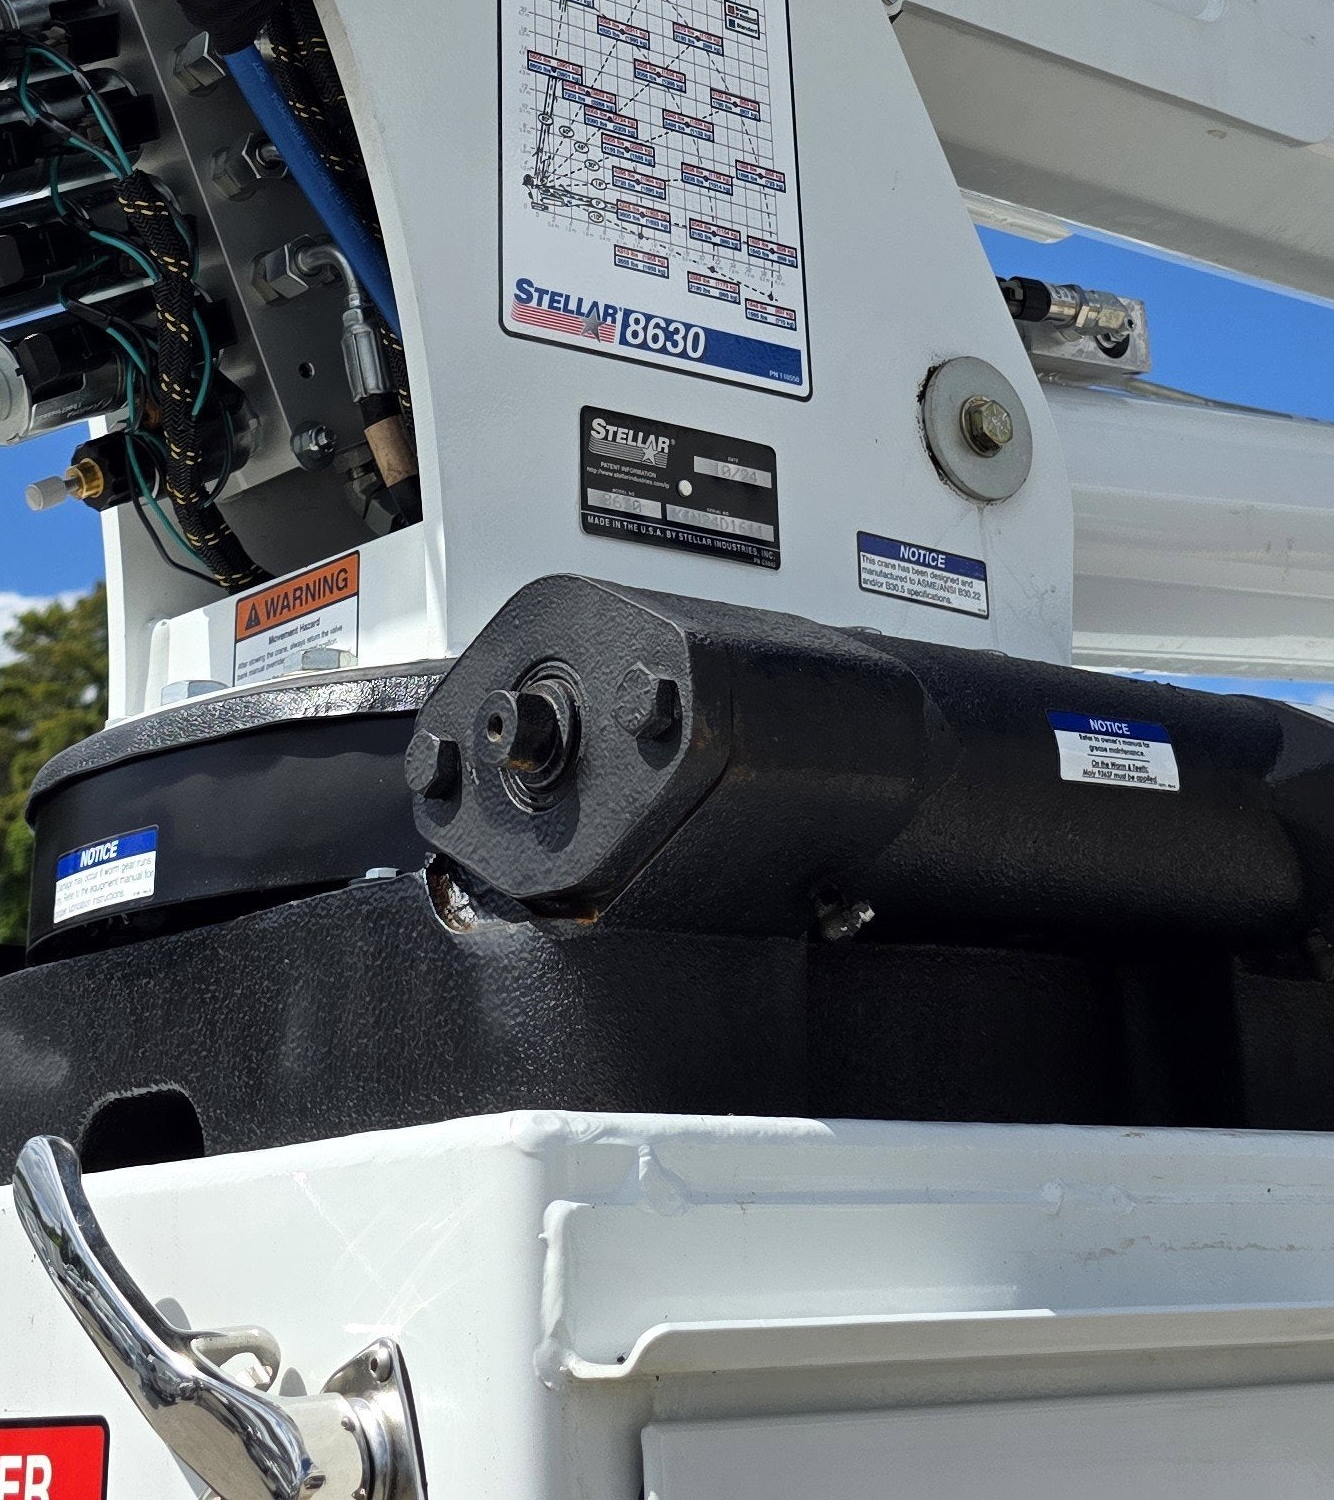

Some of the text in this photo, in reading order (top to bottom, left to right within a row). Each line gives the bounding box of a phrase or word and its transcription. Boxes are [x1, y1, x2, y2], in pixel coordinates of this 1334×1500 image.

[513, 275, 706, 360] STELLAR 8630
[590, 416, 669, 454] STELLAR
[600, 461, 619, 471] PATENT
[621, 465, 656, 478] INFORMATION
[587, 515, 610, 526] MADE
[612, 520, 619, 528] IN
[622, 522, 637, 532] THE
[666, 531, 676, 539] BY
[678, 533, 711, 546] STELLAR
[761, 550, 775, 559] INC.
[899, 544, 946, 568] NOTICE
[862, 554, 973, 588] This crane has been designed and
[862, 566, 907, 583] manufactured
[909, 576, 915, 584] to
[862, 576, 882, 588] and/or
[885, 581, 904, 593] B30.5
[264, 566, 348, 620] WARNING
[268, 625, 297, 644] Movement
[299, 617, 319, 632] Hazard
[1089, 718, 1130, 734] NOTICE
[80, 840, 119, 868] NOTICE
